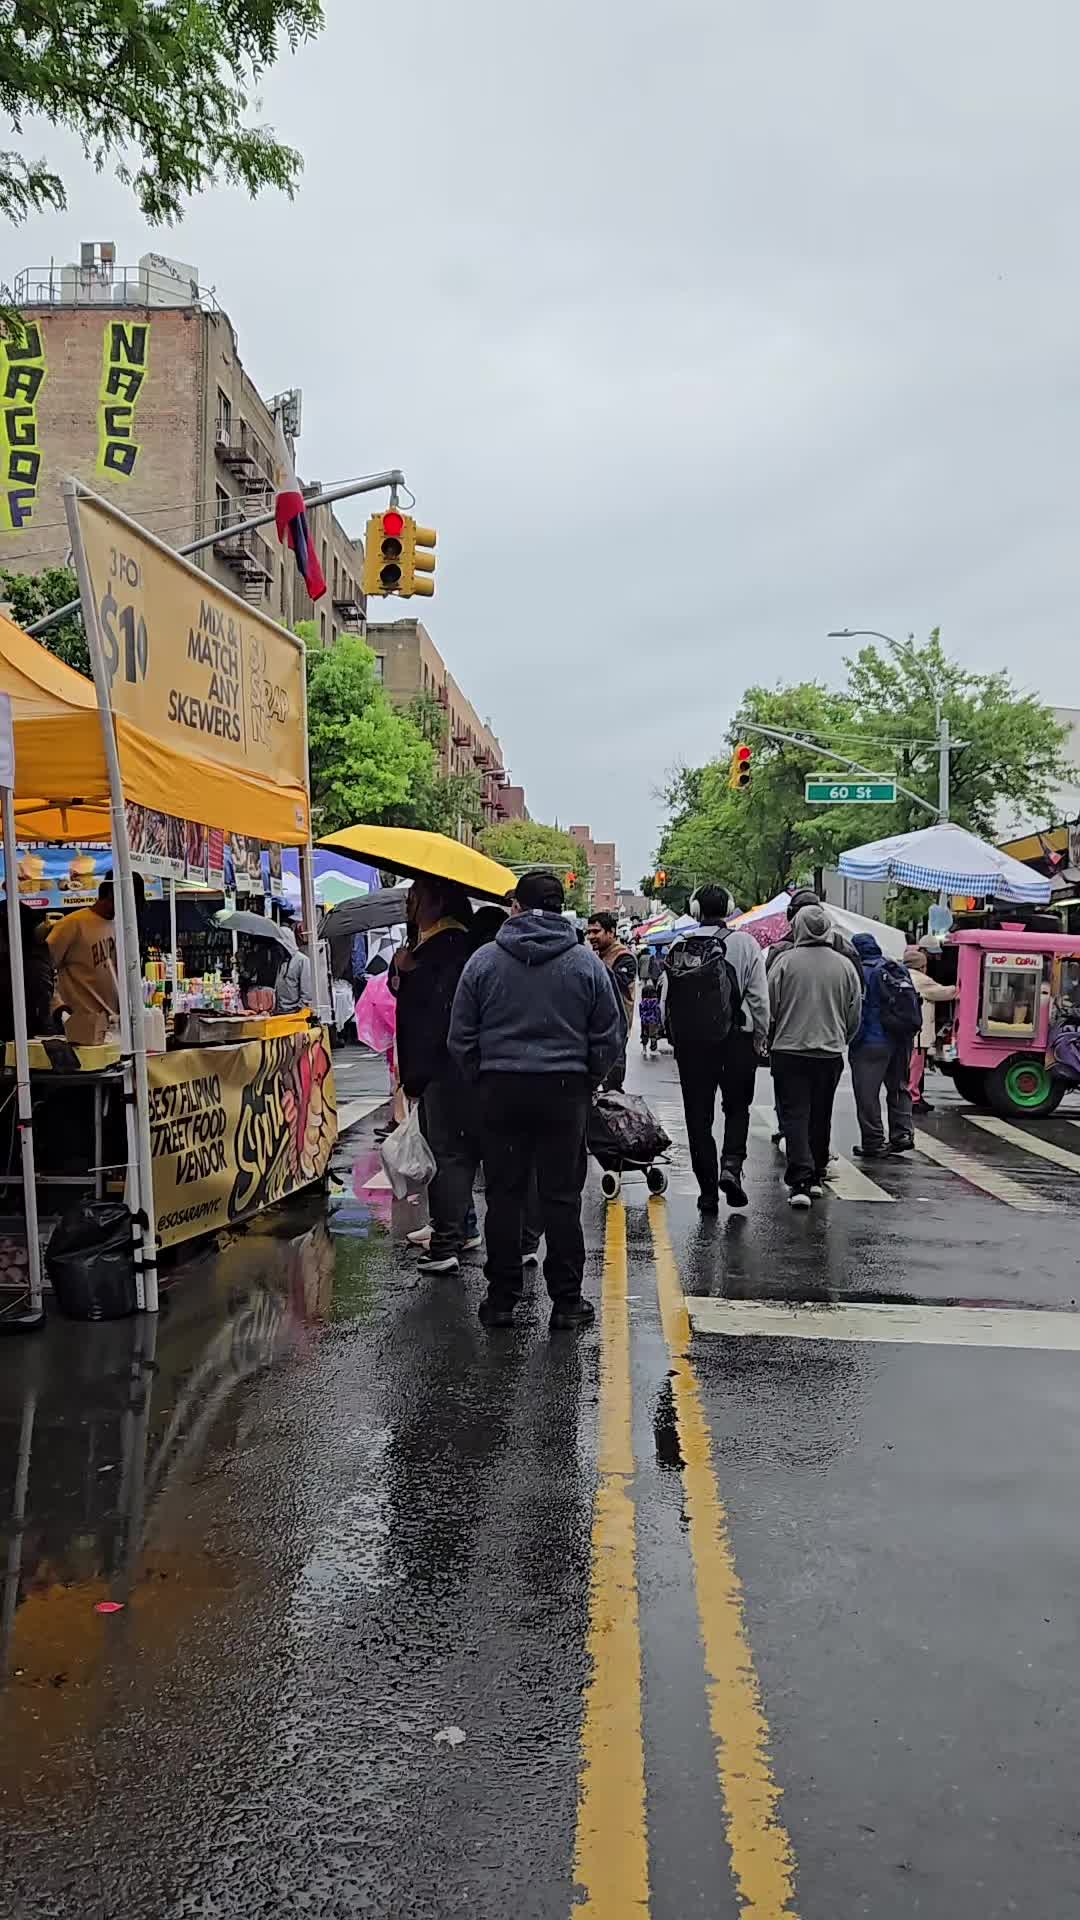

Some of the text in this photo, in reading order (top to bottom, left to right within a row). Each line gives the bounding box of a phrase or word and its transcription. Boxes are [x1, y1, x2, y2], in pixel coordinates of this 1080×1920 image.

[103, 323, 147, 477] NACO
[119, 552, 142, 588] FO
[199, 599, 226, 643] MIX
[187, 627, 239, 681] MATCH
[208, 671, 239, 710] ANY
[167, 688, 241, 742] SKEWERS
[829, 786, 872, 799] 60 St
[991, 956, 1008, 965] POP
[150, 1107, 227, 1158] TREET FOOD
[175, 1140, 228, 1185] VENDOR
